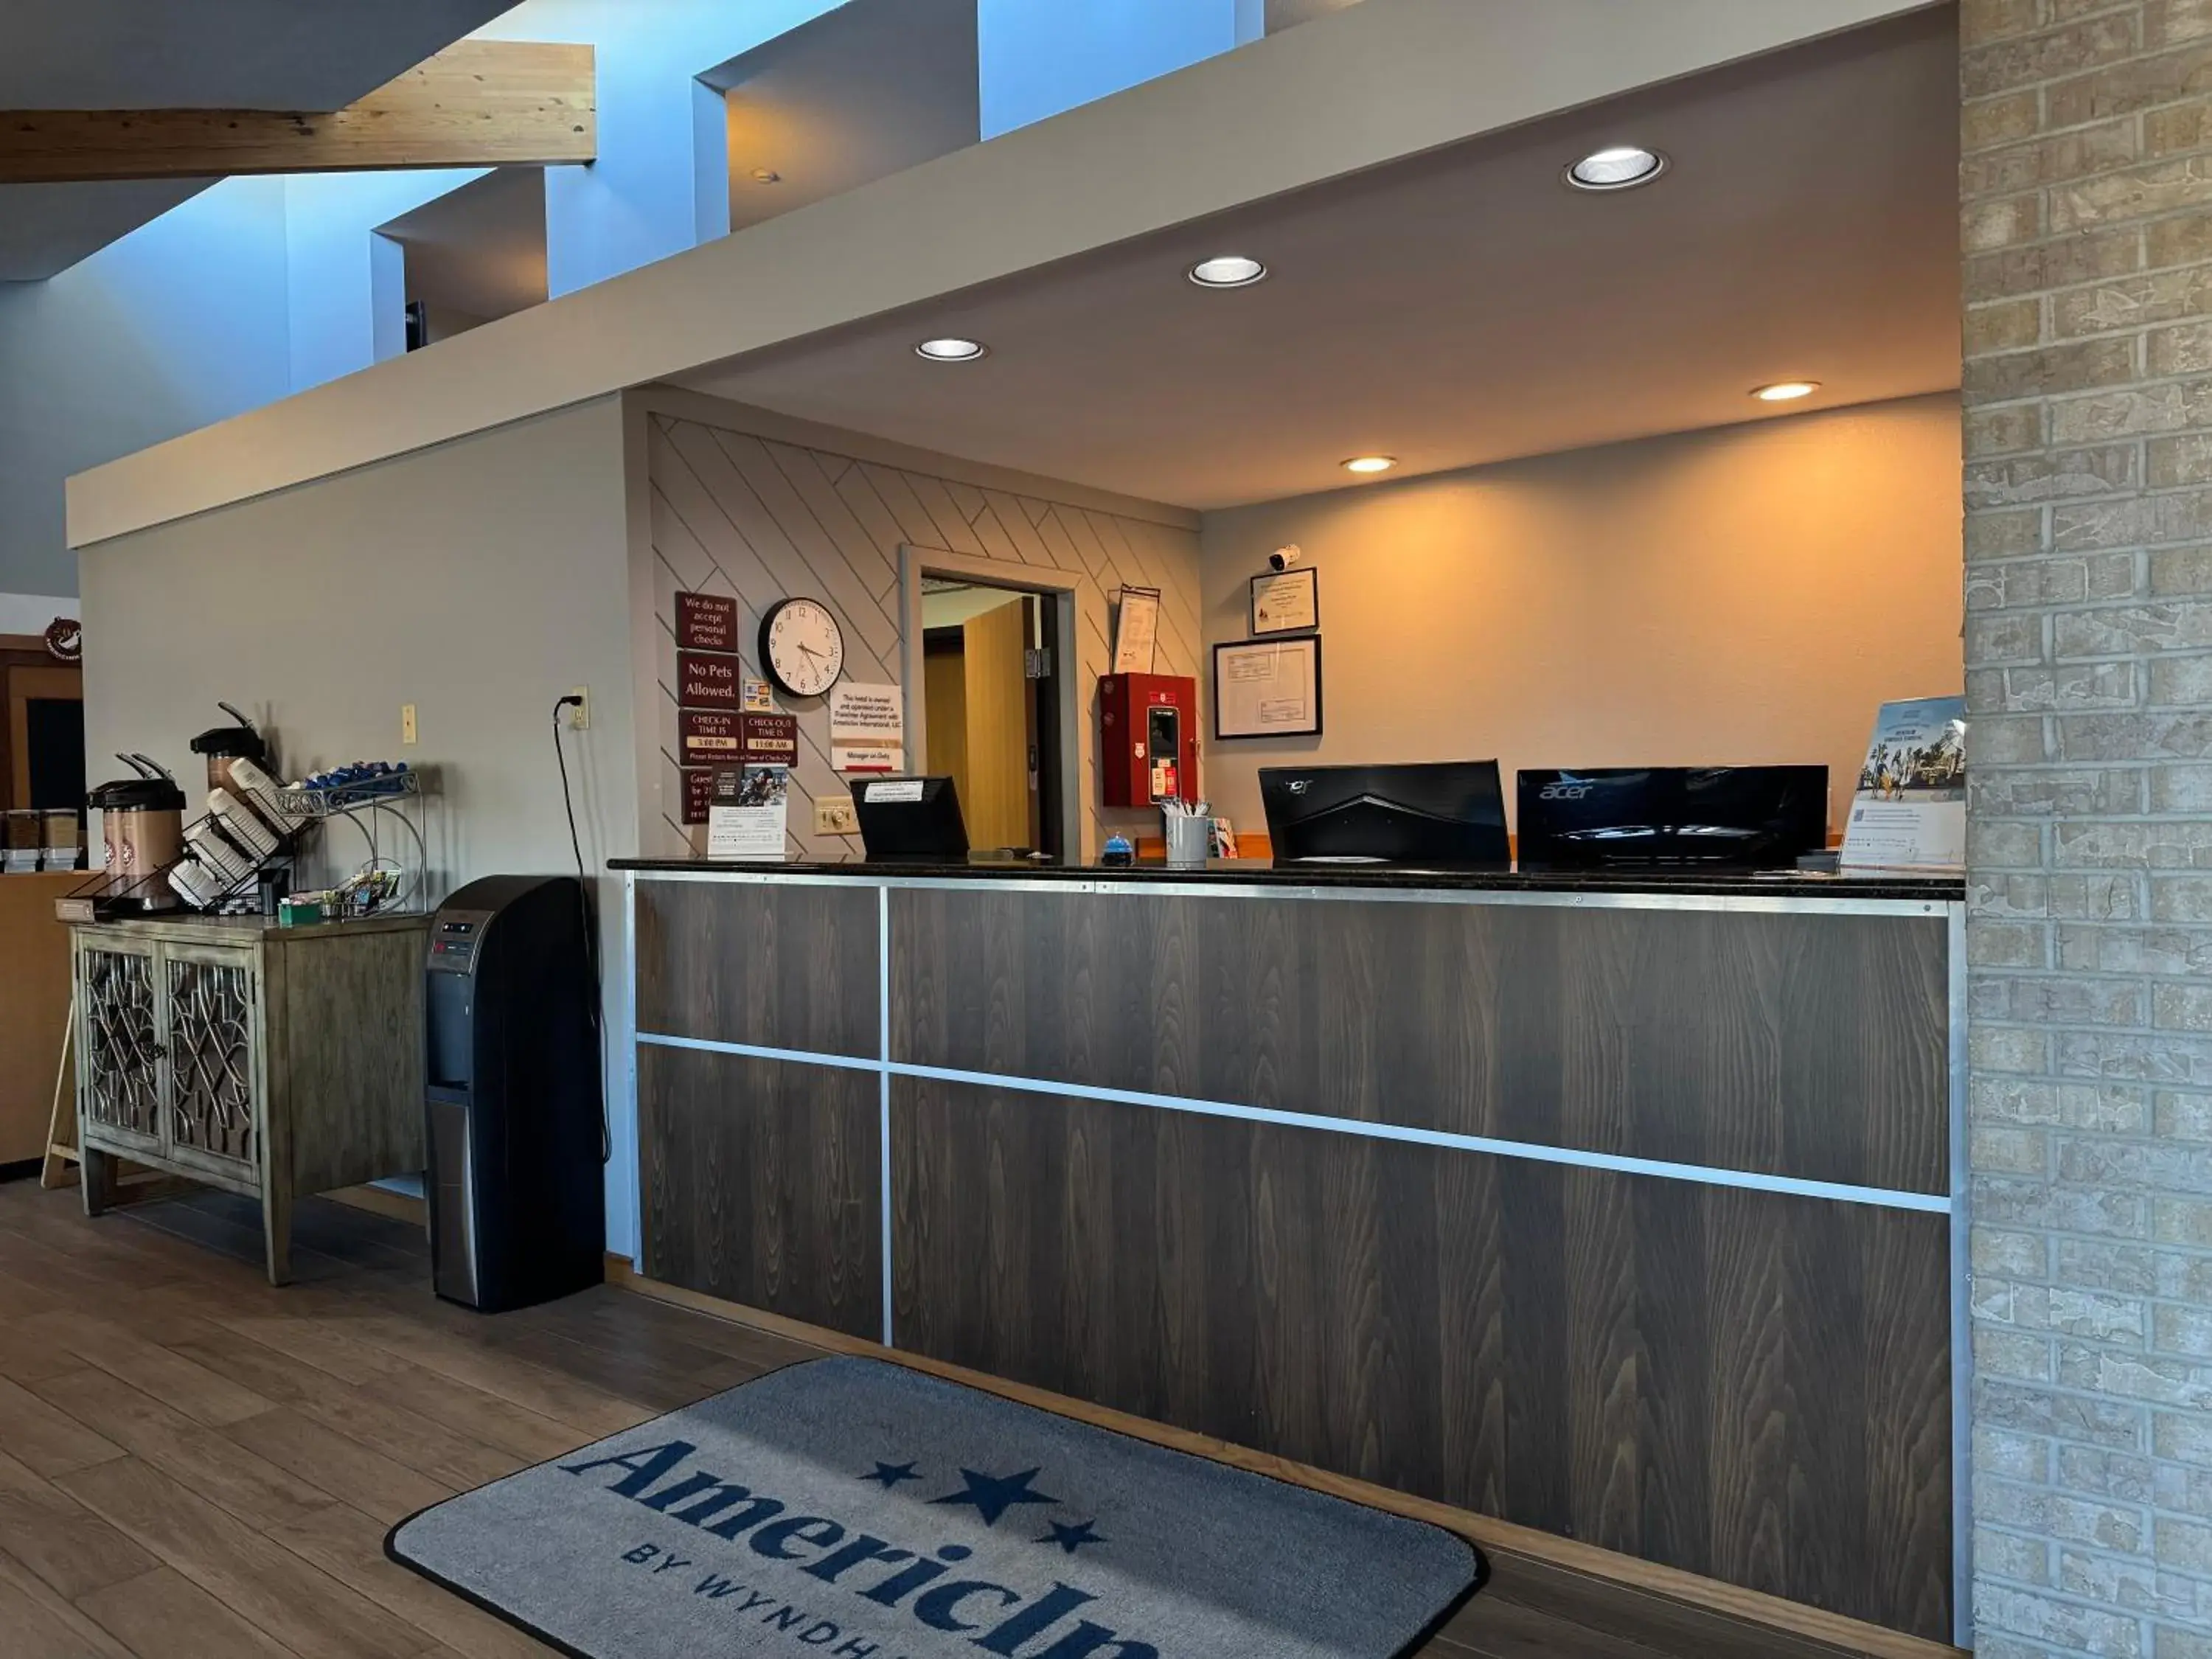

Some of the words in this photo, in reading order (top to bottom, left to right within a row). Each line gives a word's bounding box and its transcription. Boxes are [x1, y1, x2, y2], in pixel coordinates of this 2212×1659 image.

[684, 597, 700, 608] We
[701, 599, 713, 611] do
[714, 603, 730, 613] not
[785, 611, 791, 620] 11
[799, 607, 806, 617] 12
[694, 613, 723, 625] accept
[689, 624, 726, 635] personal
[775, 622, 783, 633] 10
[771, 639, 776, 648] 9
[775, 658, 781, 668] 8
[689, 663, 707, 677] No
[709, 664, 732, 678] Pets
[824, 664, 830, 674] 4
[785, 672, 791, 681] 7
[800, 679, 806, 689] 6
[699, 726, 717, 735] TIME
[719, 727, 726, 736] IS
[758, 728, 774, 737] TIME
[714, 739, 728, 747] PM
[776, 741, 787, 749] AM
[1538, 785, 1593, 799] acer
[621, 1543, 692, 1574] BY
[693, 1573, 910, 1659] WYNDH
